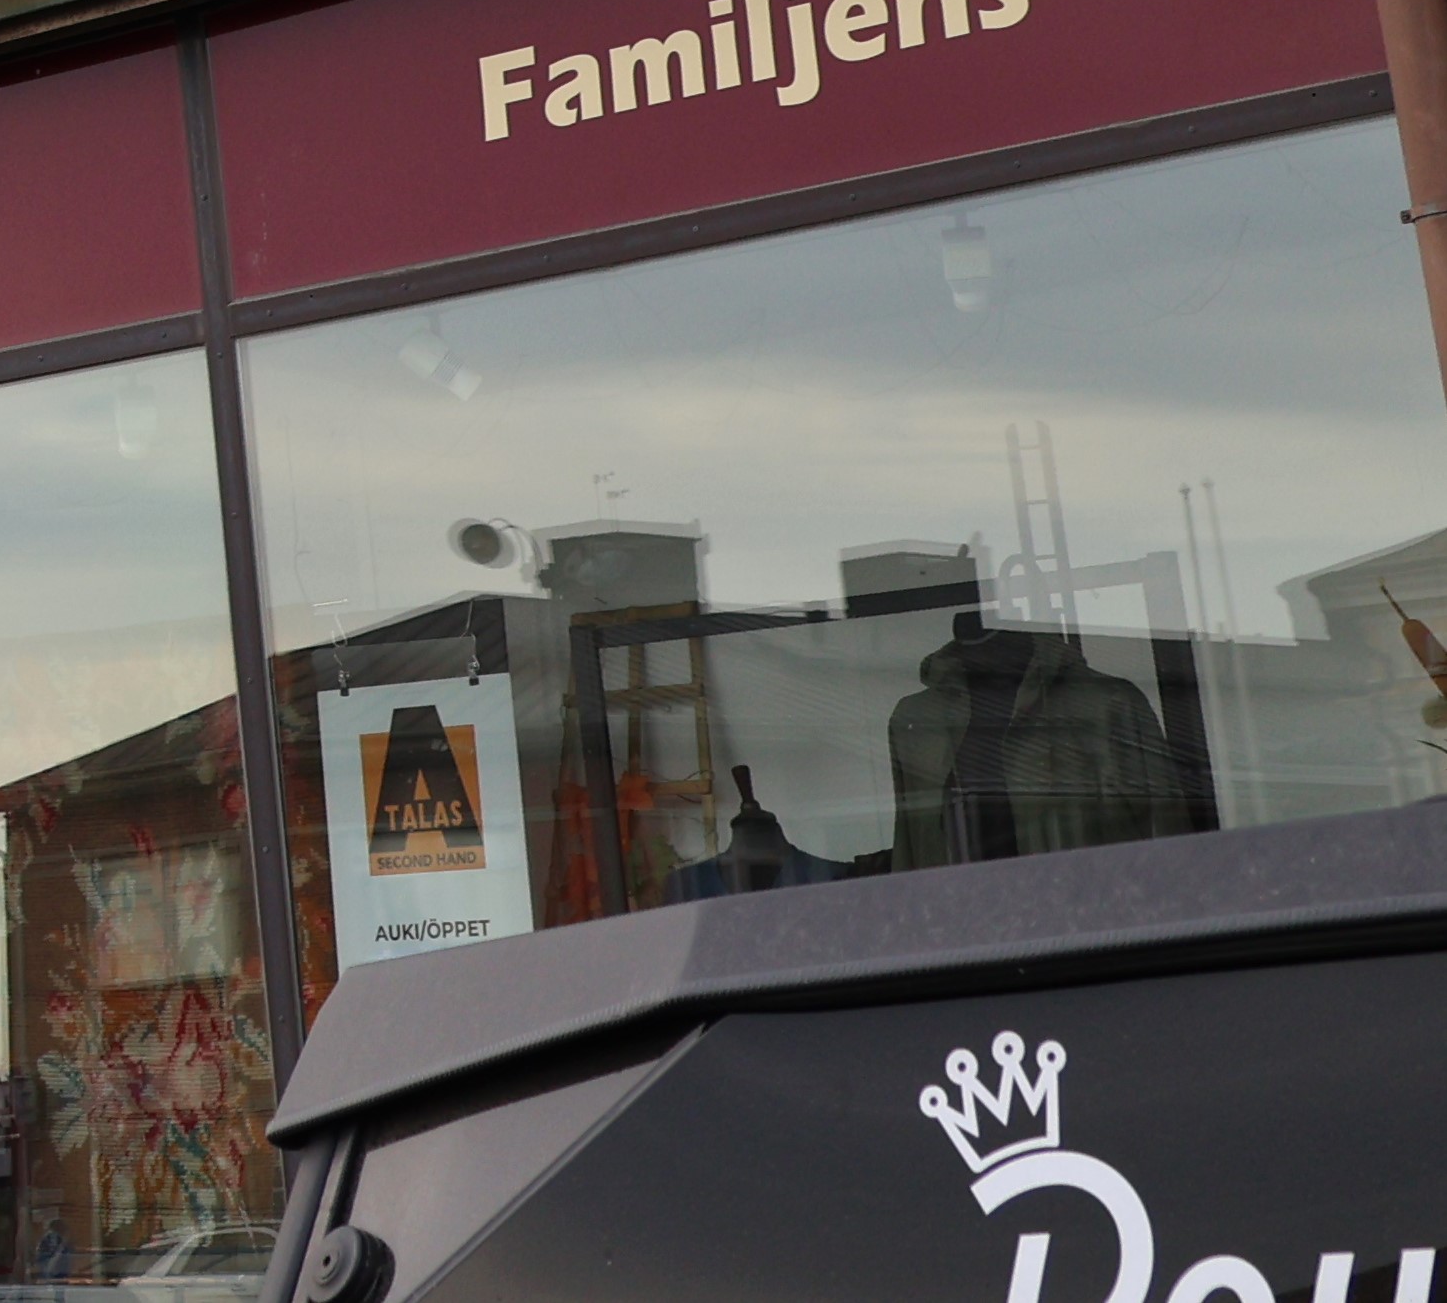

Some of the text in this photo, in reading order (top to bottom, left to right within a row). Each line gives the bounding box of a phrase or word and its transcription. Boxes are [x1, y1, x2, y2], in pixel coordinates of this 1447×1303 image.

[383, 800, 464, 832] TALAS
[376, 851, 477, 870] SECOND HAND
[374, 917, 491, 943] AUKI/ÖPPET
